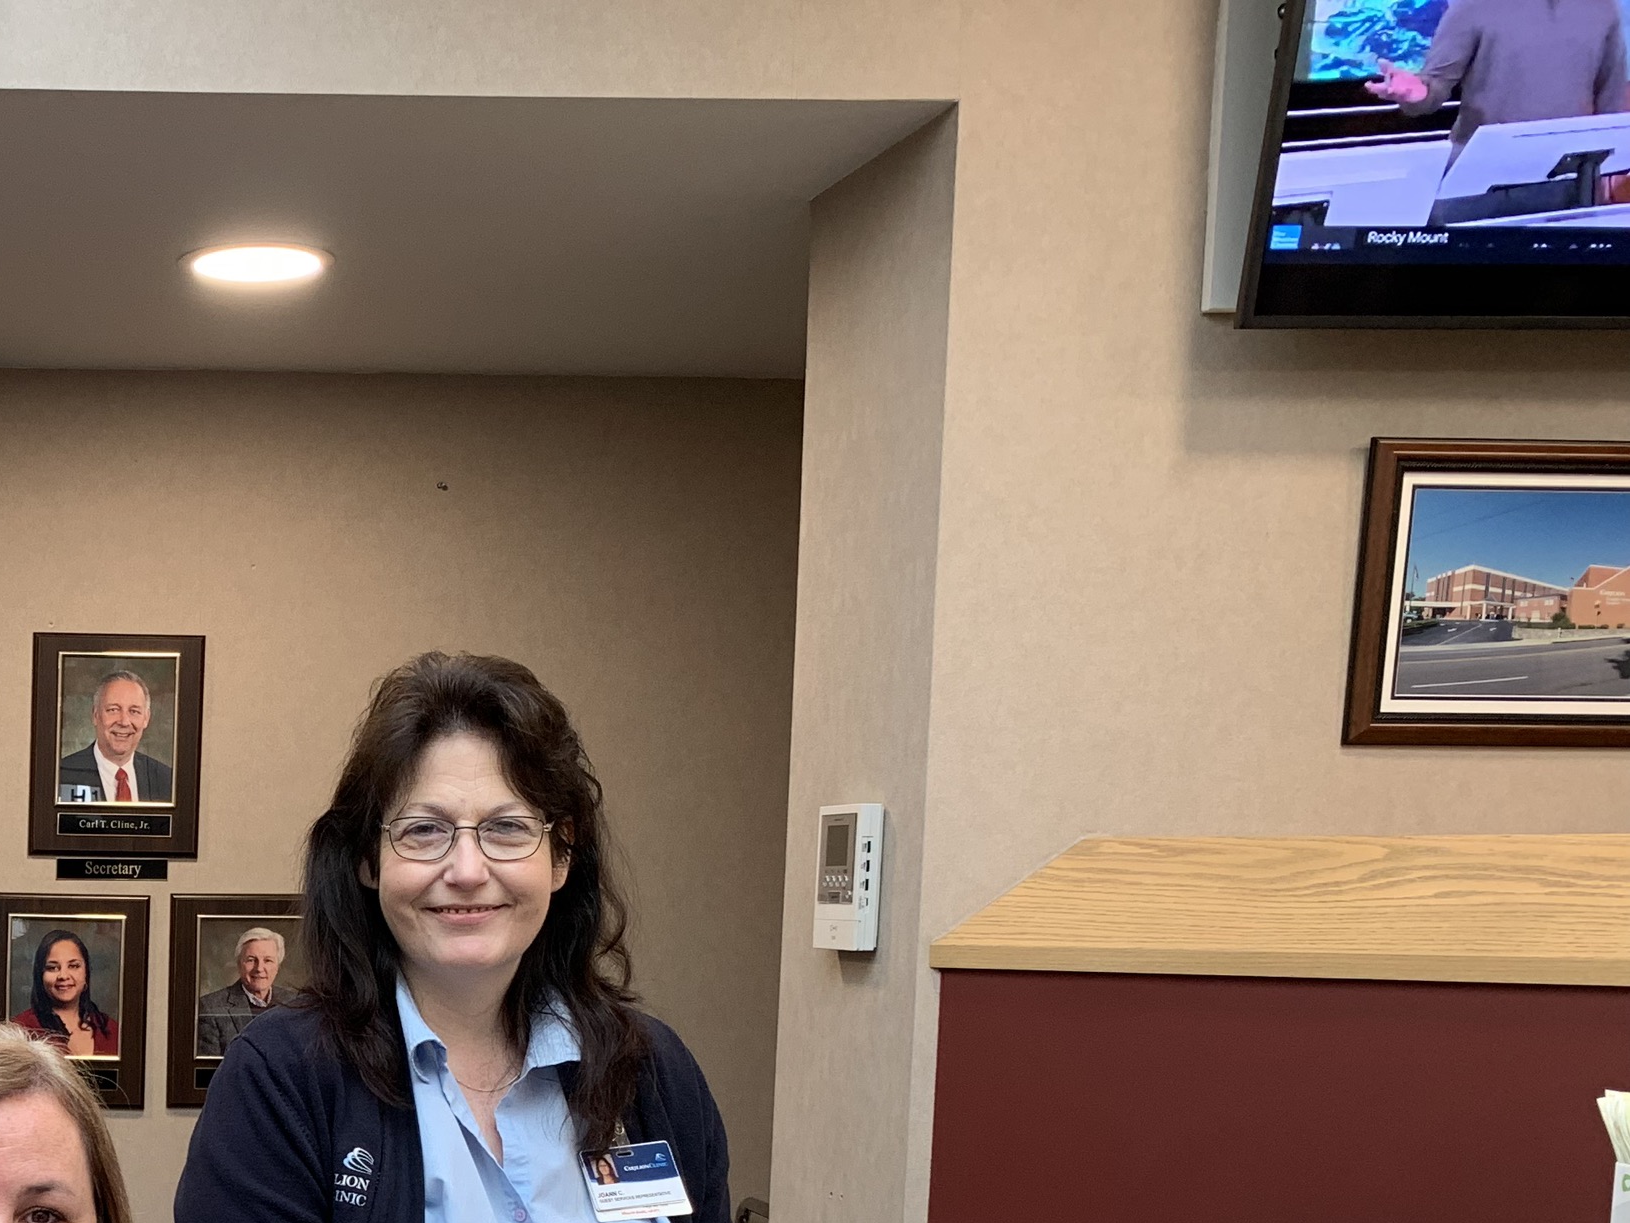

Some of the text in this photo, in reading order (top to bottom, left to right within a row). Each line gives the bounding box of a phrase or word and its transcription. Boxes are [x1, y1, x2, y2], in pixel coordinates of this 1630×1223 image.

[1367, 231, 1449, 246] Rocky Mount
[79, 819, 150, 830] Carl T. Cline, Jr.
[85, 860, 142, 878] Secretary
[334, 1173, 370, 1191] LION
[335, 1189, 367, 1207] INIC
